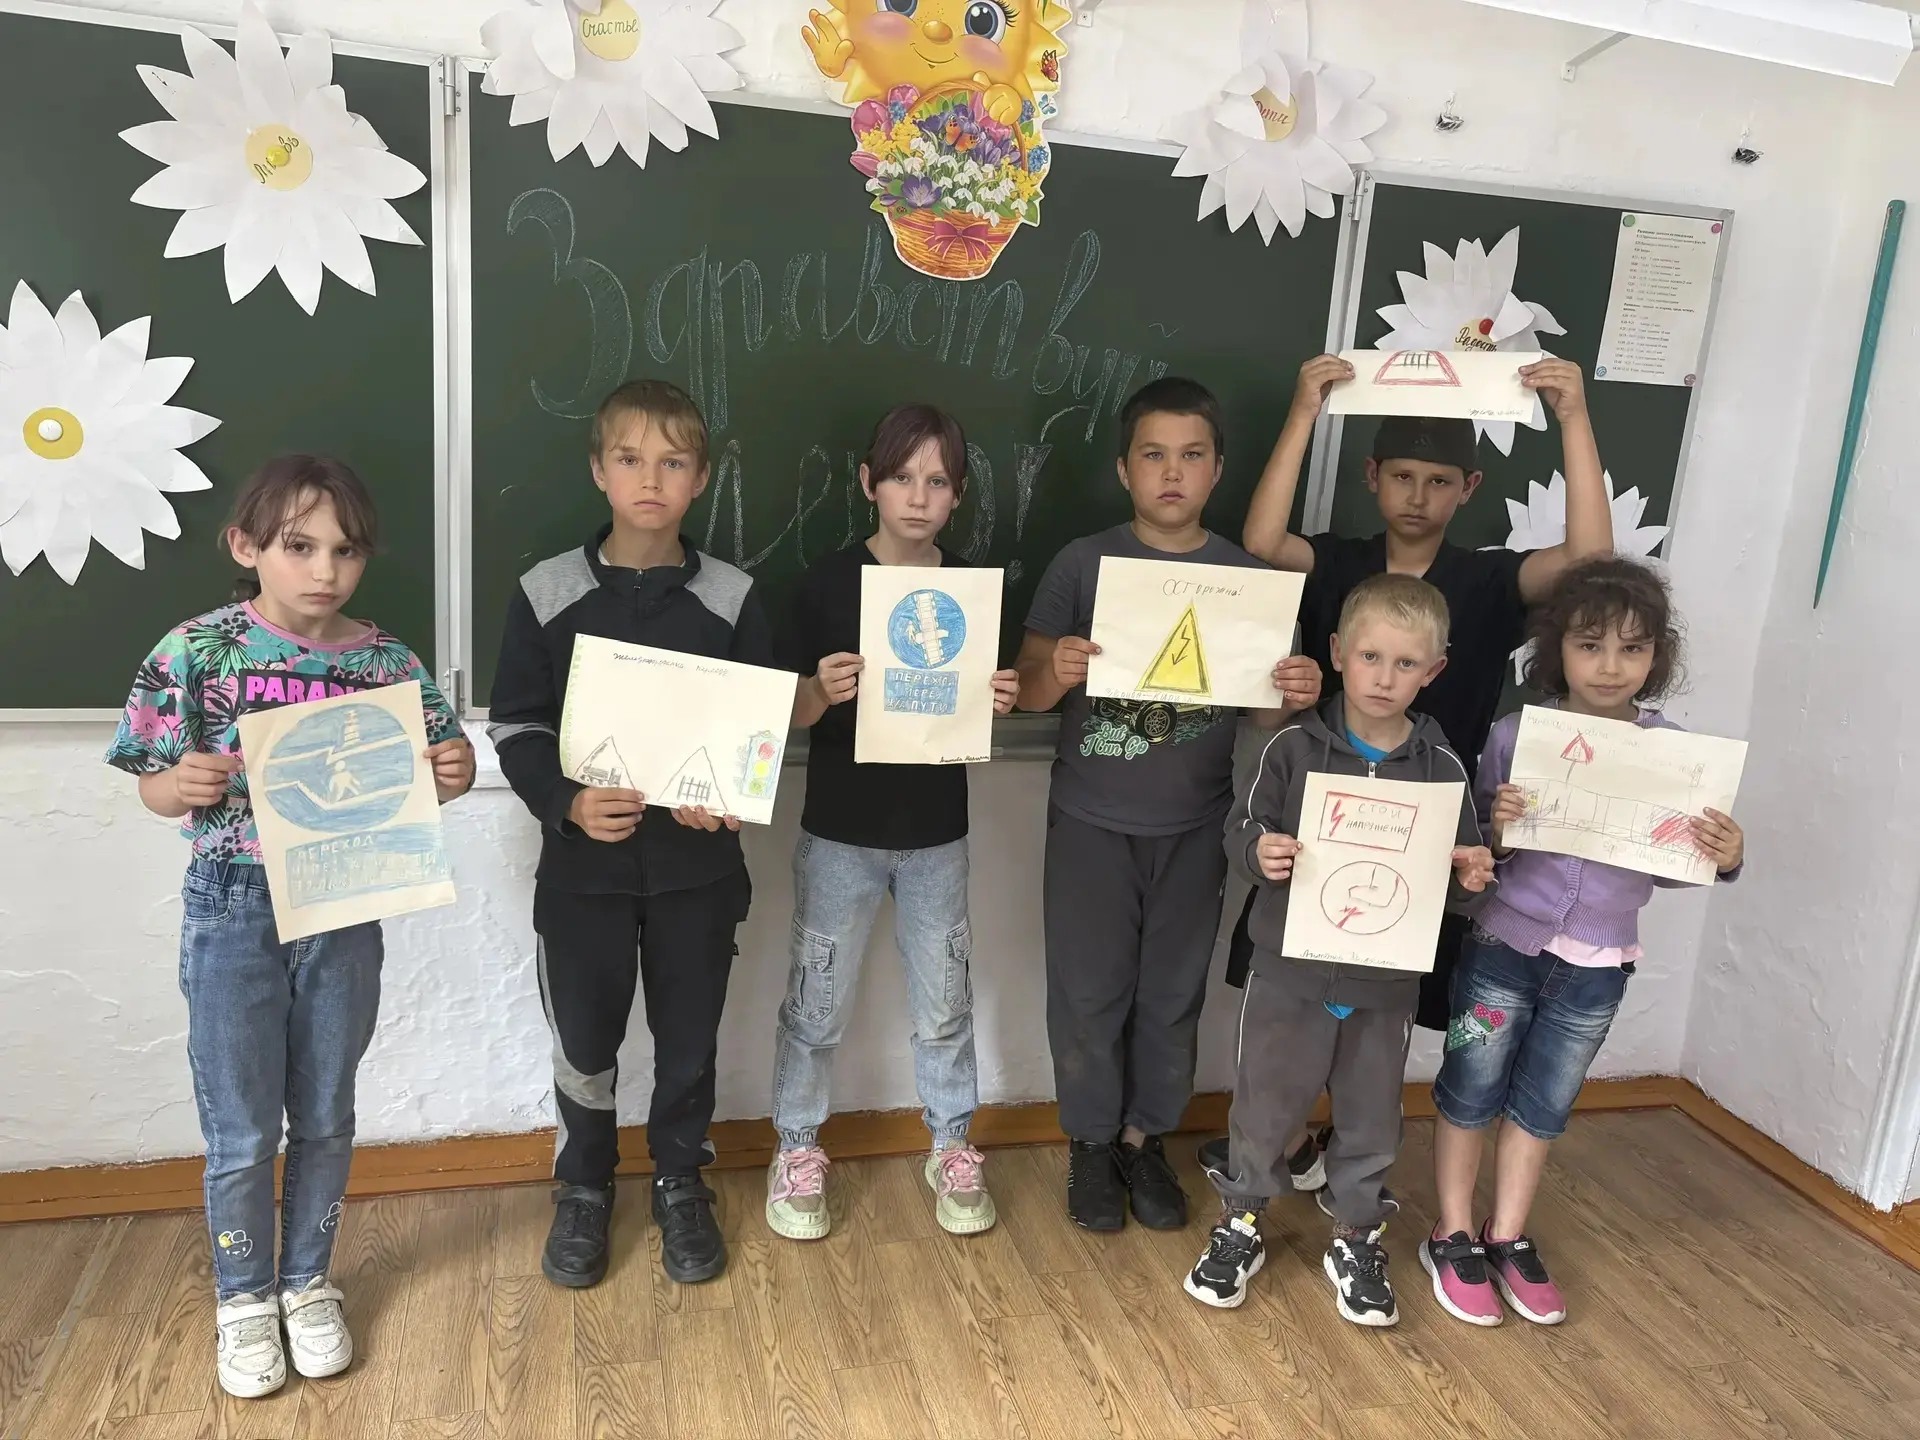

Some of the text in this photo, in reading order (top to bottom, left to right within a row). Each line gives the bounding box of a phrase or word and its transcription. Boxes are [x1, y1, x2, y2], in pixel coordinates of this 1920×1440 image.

[582, 18, 638, 38] Счастье
[1098, 721, 1127, 741] But
[1094, 736, 1123, 757] Can
[1124, 735, 1149, 760] Go
